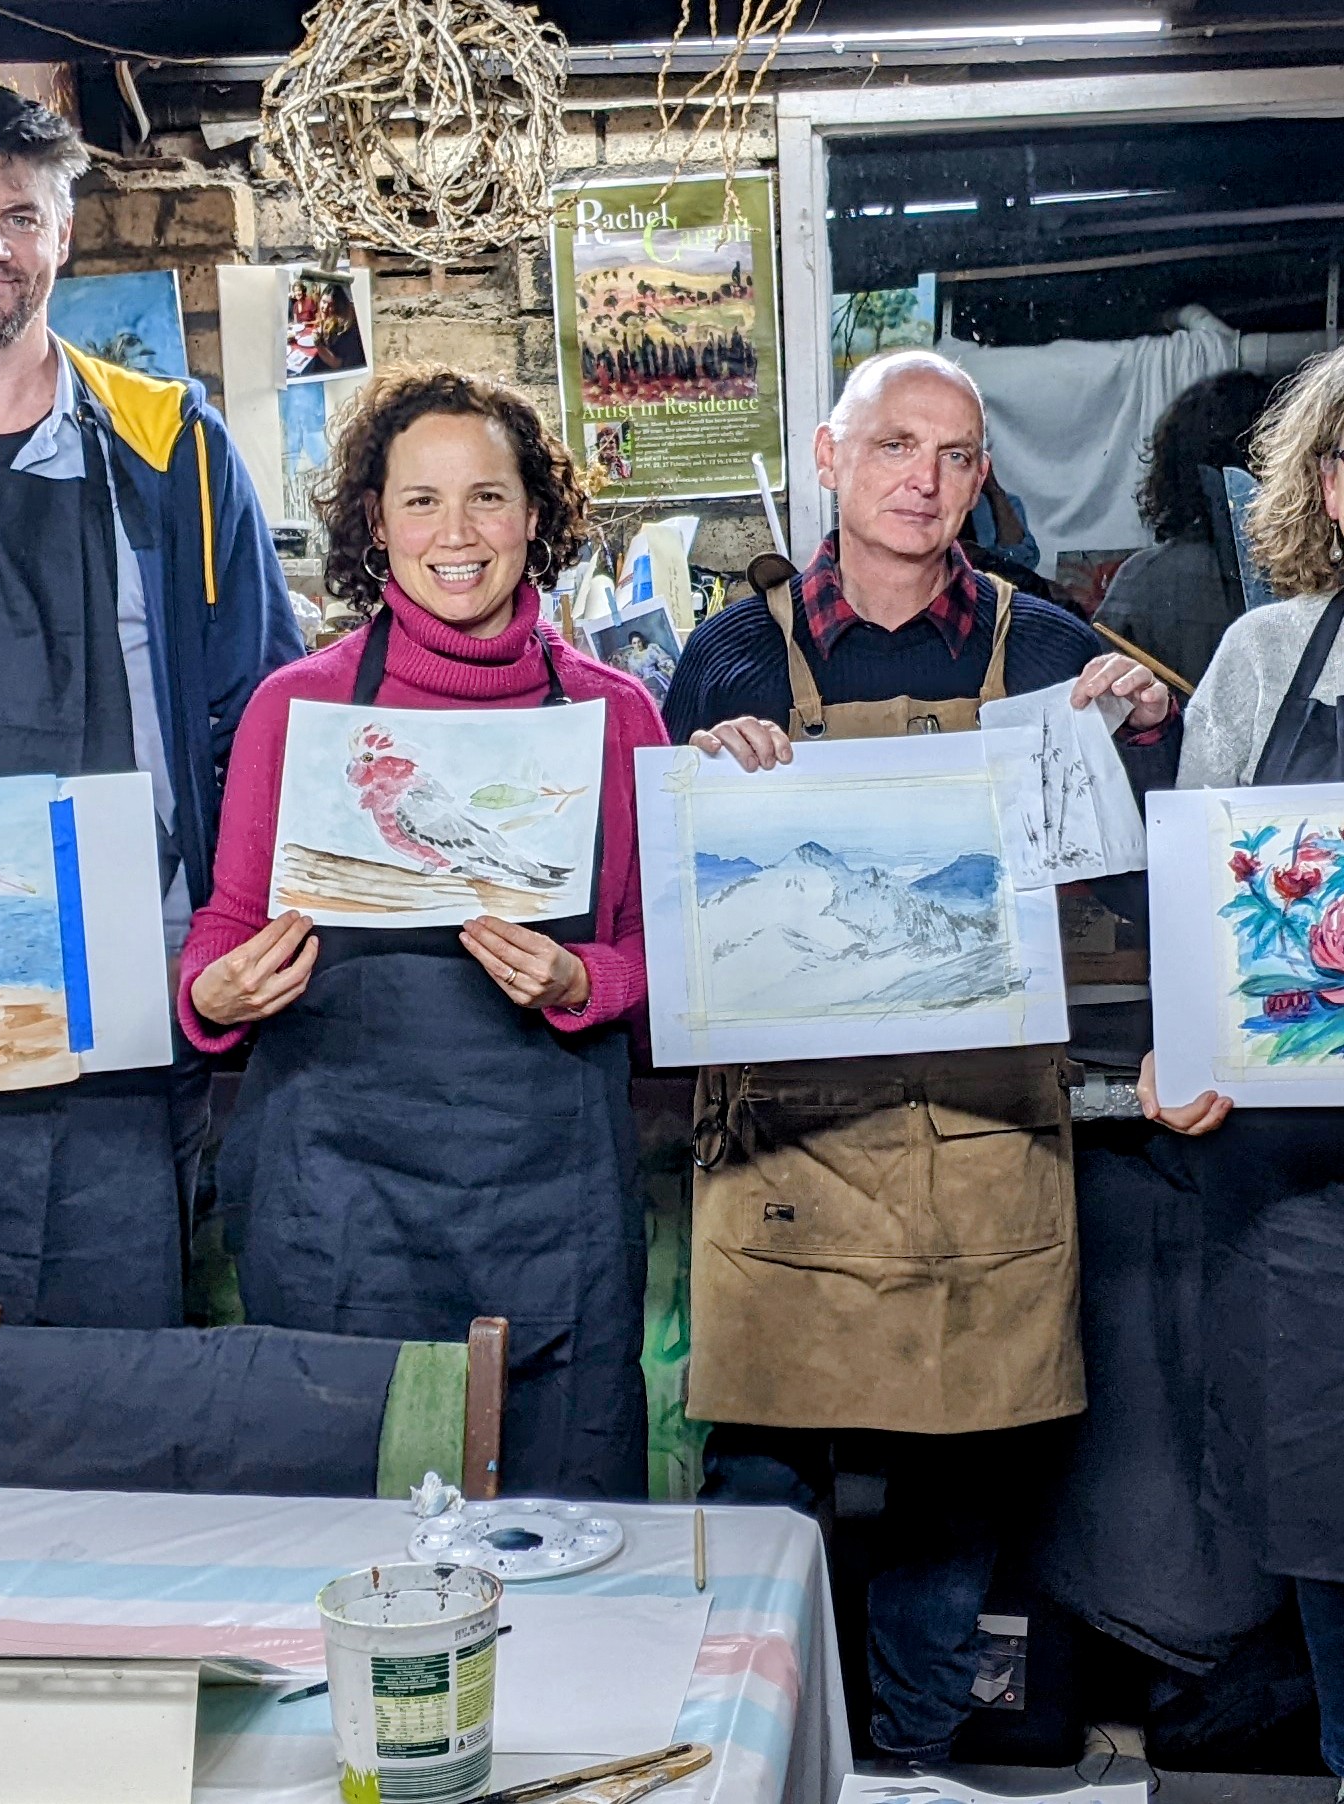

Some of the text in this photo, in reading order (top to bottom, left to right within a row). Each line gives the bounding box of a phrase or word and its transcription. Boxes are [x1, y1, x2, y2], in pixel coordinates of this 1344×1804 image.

[576, 198, 669, 246] Rachel
[643, 216, 752, 264] Carroll
[582, 394, 760, 420] Artist in Residence
